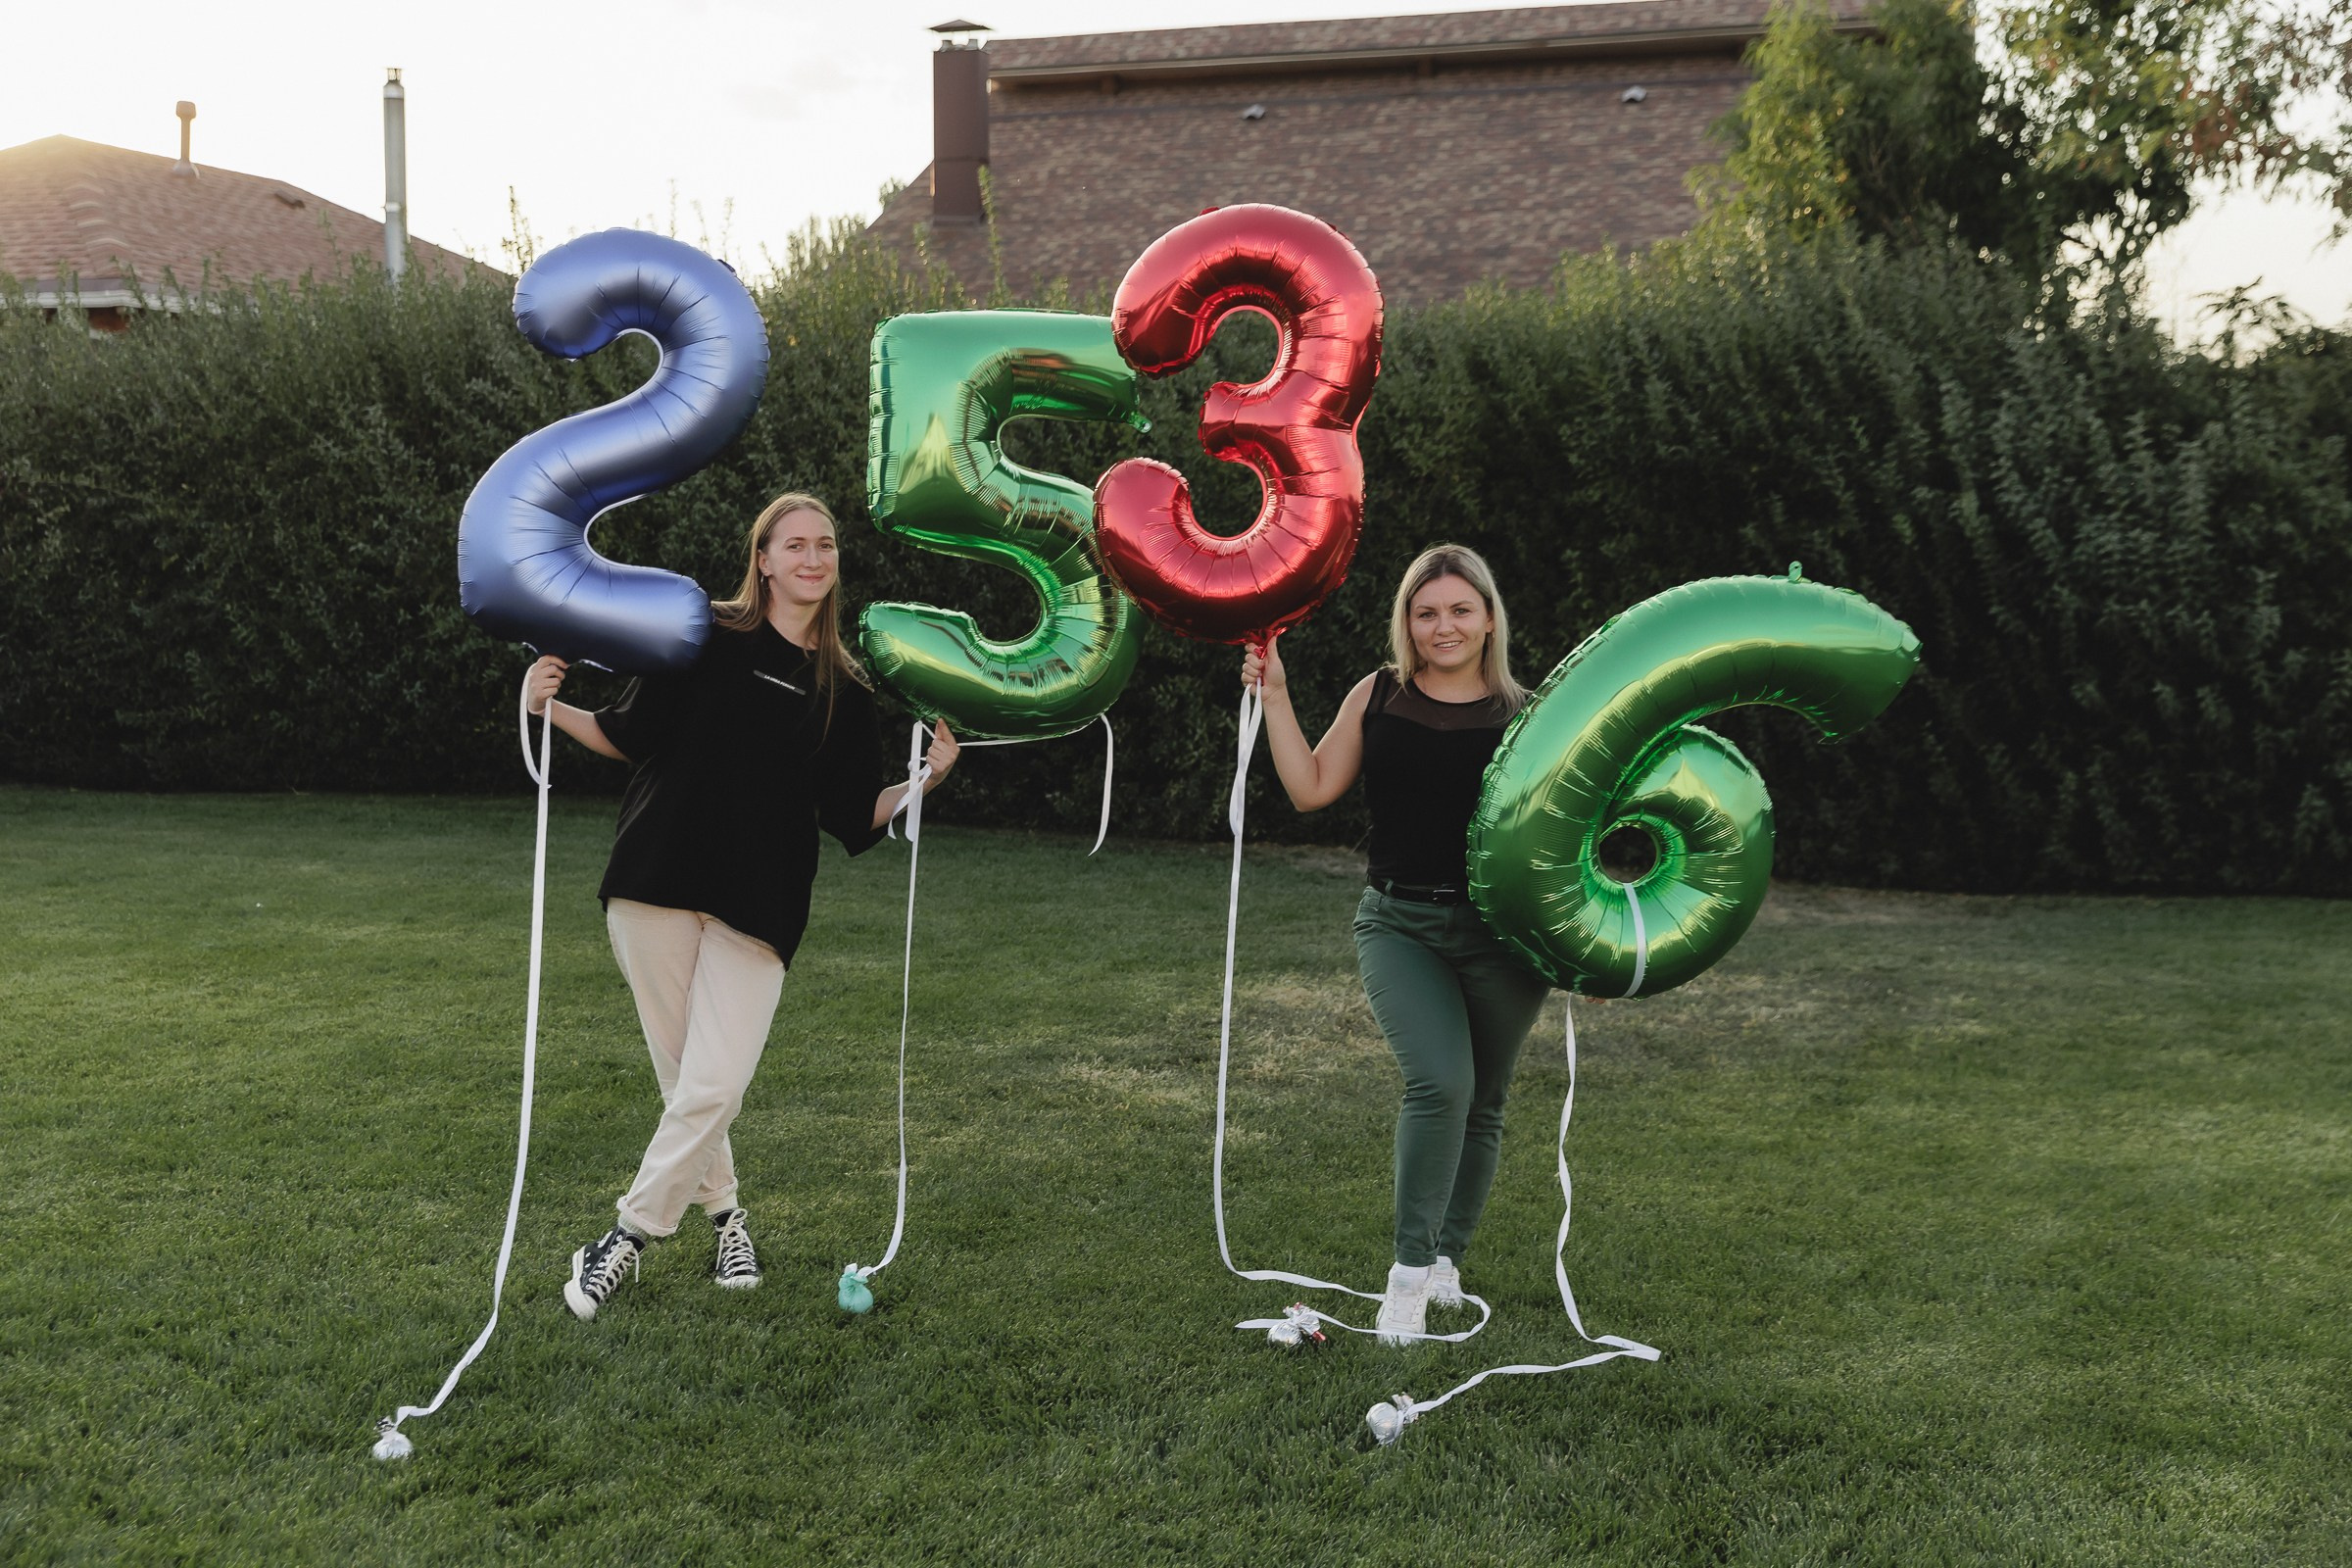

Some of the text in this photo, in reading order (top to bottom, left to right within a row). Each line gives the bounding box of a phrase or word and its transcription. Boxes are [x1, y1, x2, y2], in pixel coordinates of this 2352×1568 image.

[458, 227, 769, 674] 2
[859, 309, 1149, 740] 5
[1093, 203, 1385, 644] 3
[1466, 573, 1923, 1001] 6
